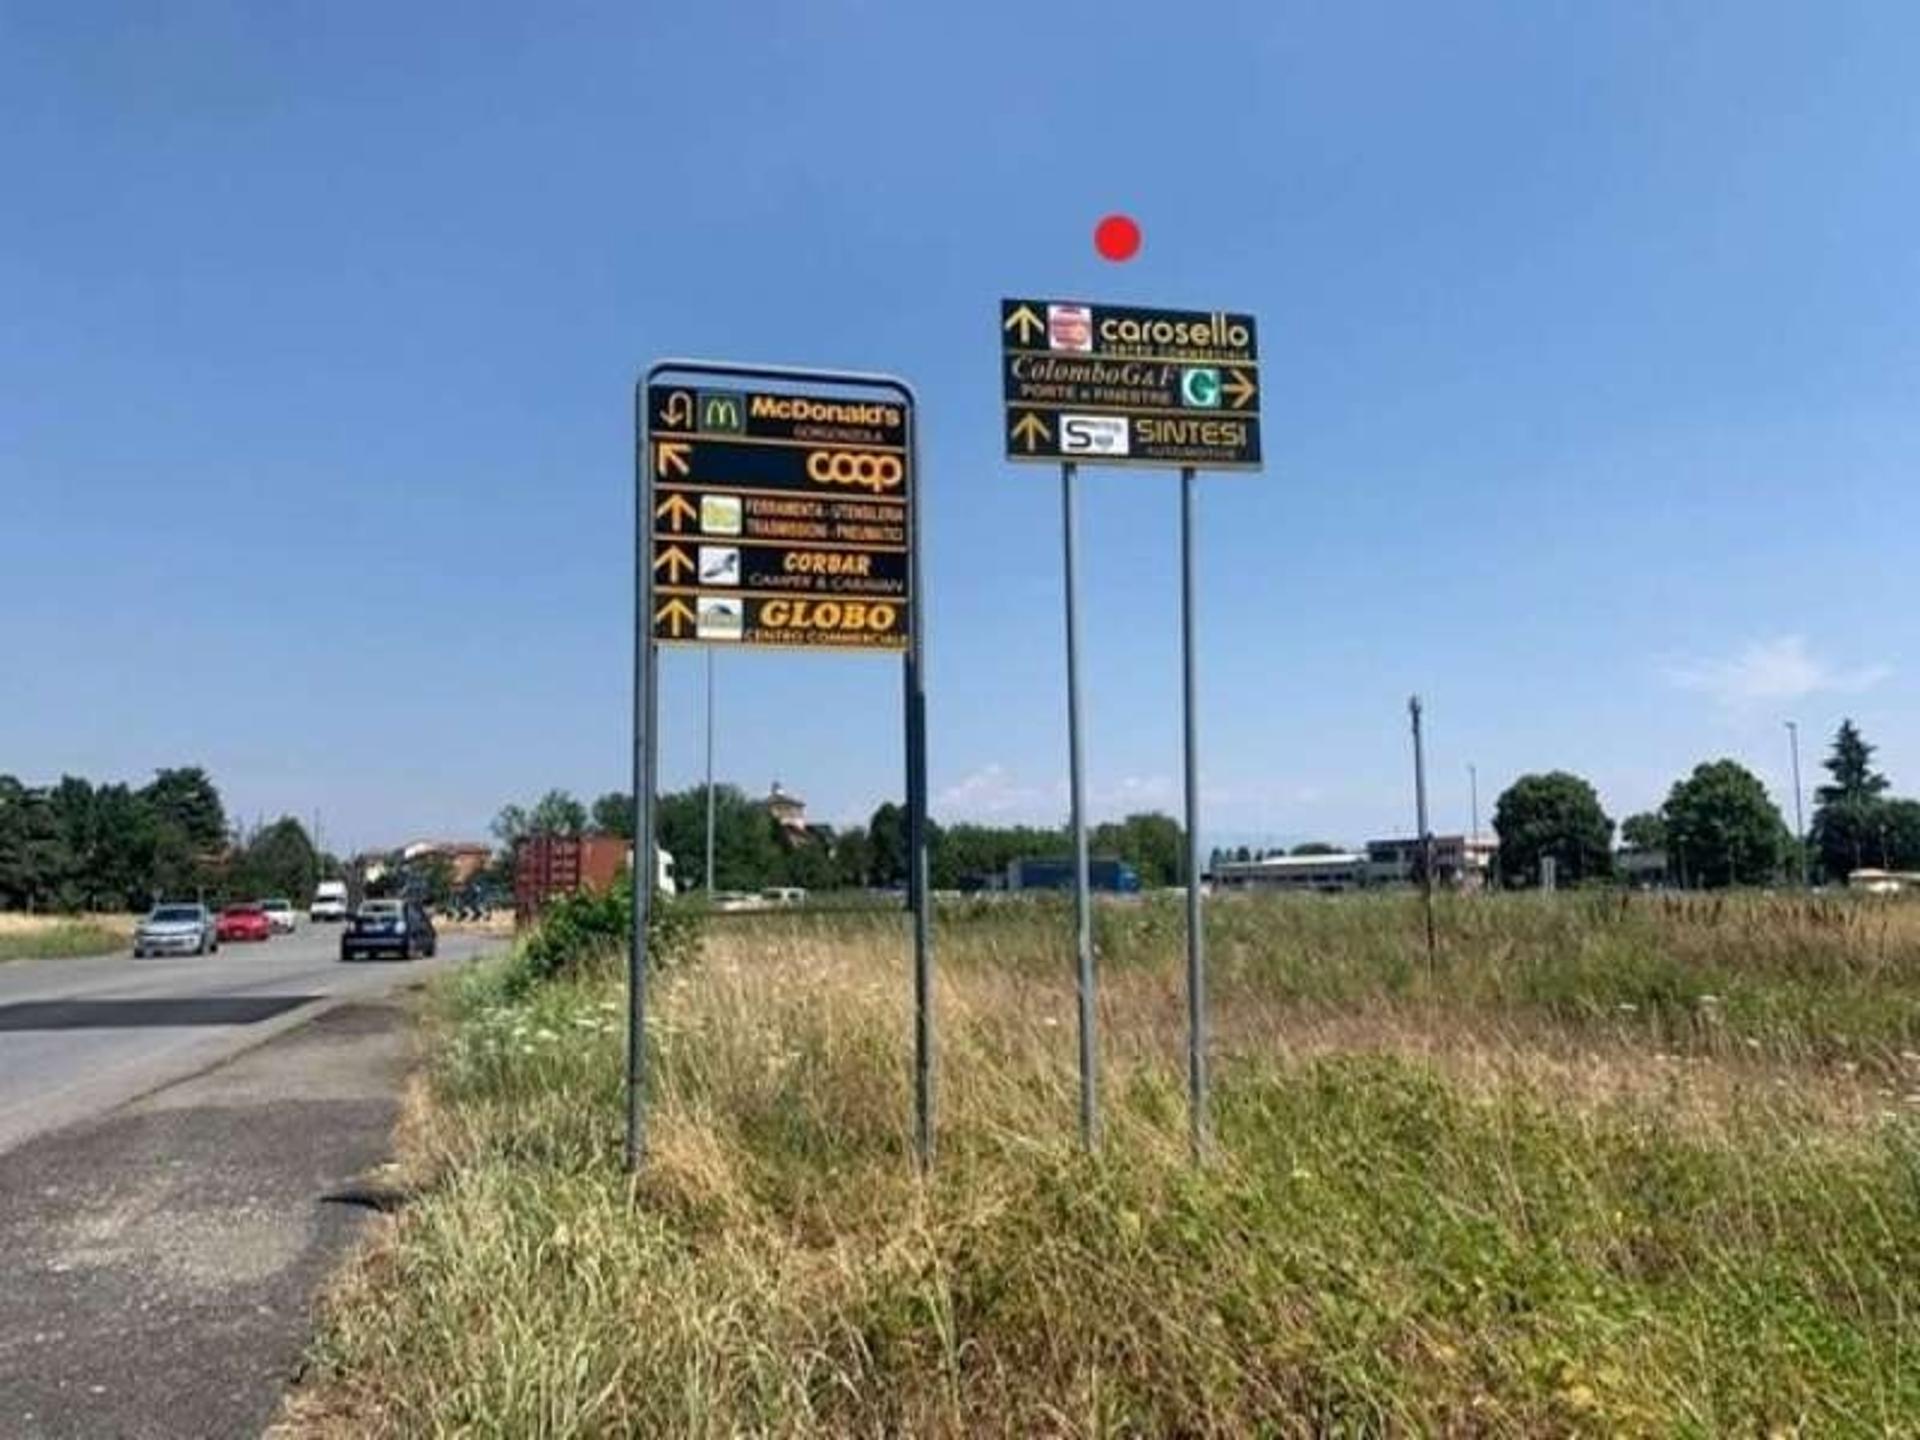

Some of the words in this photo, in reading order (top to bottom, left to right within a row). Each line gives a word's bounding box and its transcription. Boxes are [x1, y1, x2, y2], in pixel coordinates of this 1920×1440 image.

[1100, 311, 1249, 347] carosello
[750, 396, 900, 428] McDonald's
[1136, 419, 1246, 448] SINTESI
[783, 551, 870, 577] CORBAR
[760, 600, 895, 632] GLOBO
